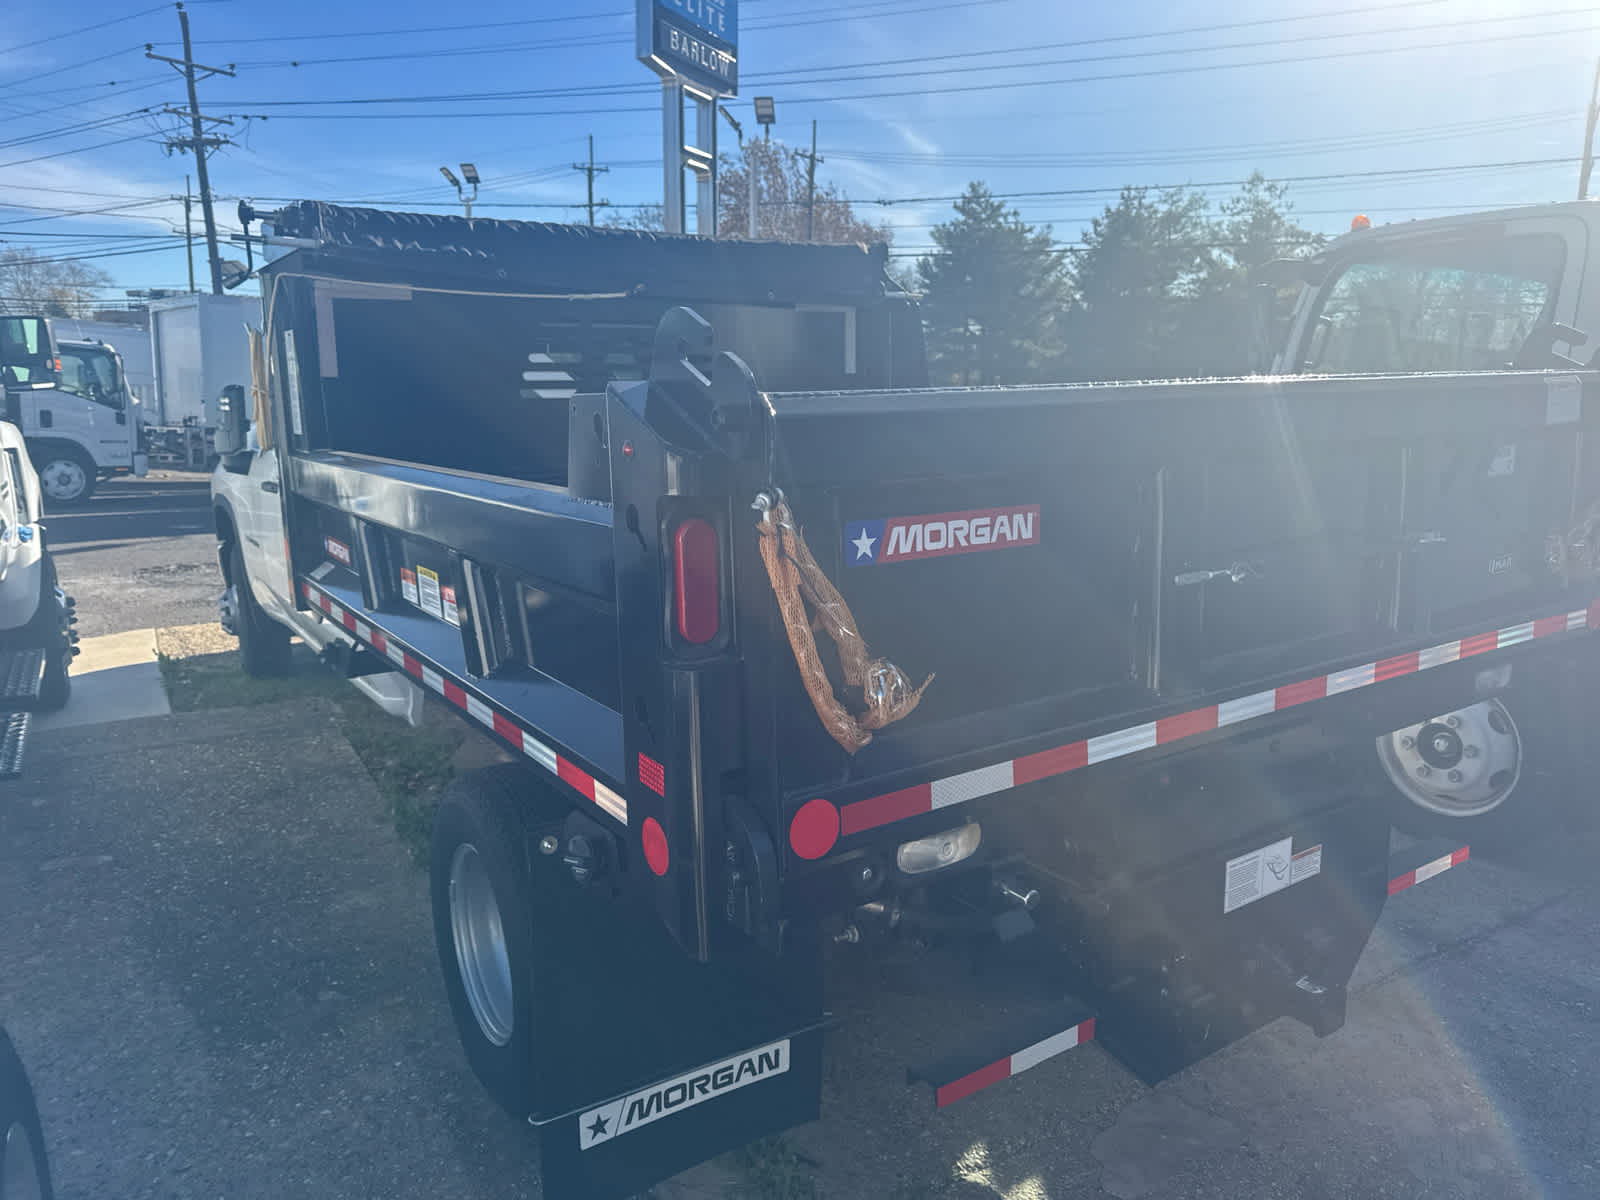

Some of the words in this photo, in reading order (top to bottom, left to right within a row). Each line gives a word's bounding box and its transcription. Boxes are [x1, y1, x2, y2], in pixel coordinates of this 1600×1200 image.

[670, 29, 730, 78] BARLOW
[887, 512, 1034, 556] MORGAN
[625, 1048, 781, 1126] MORGAN
